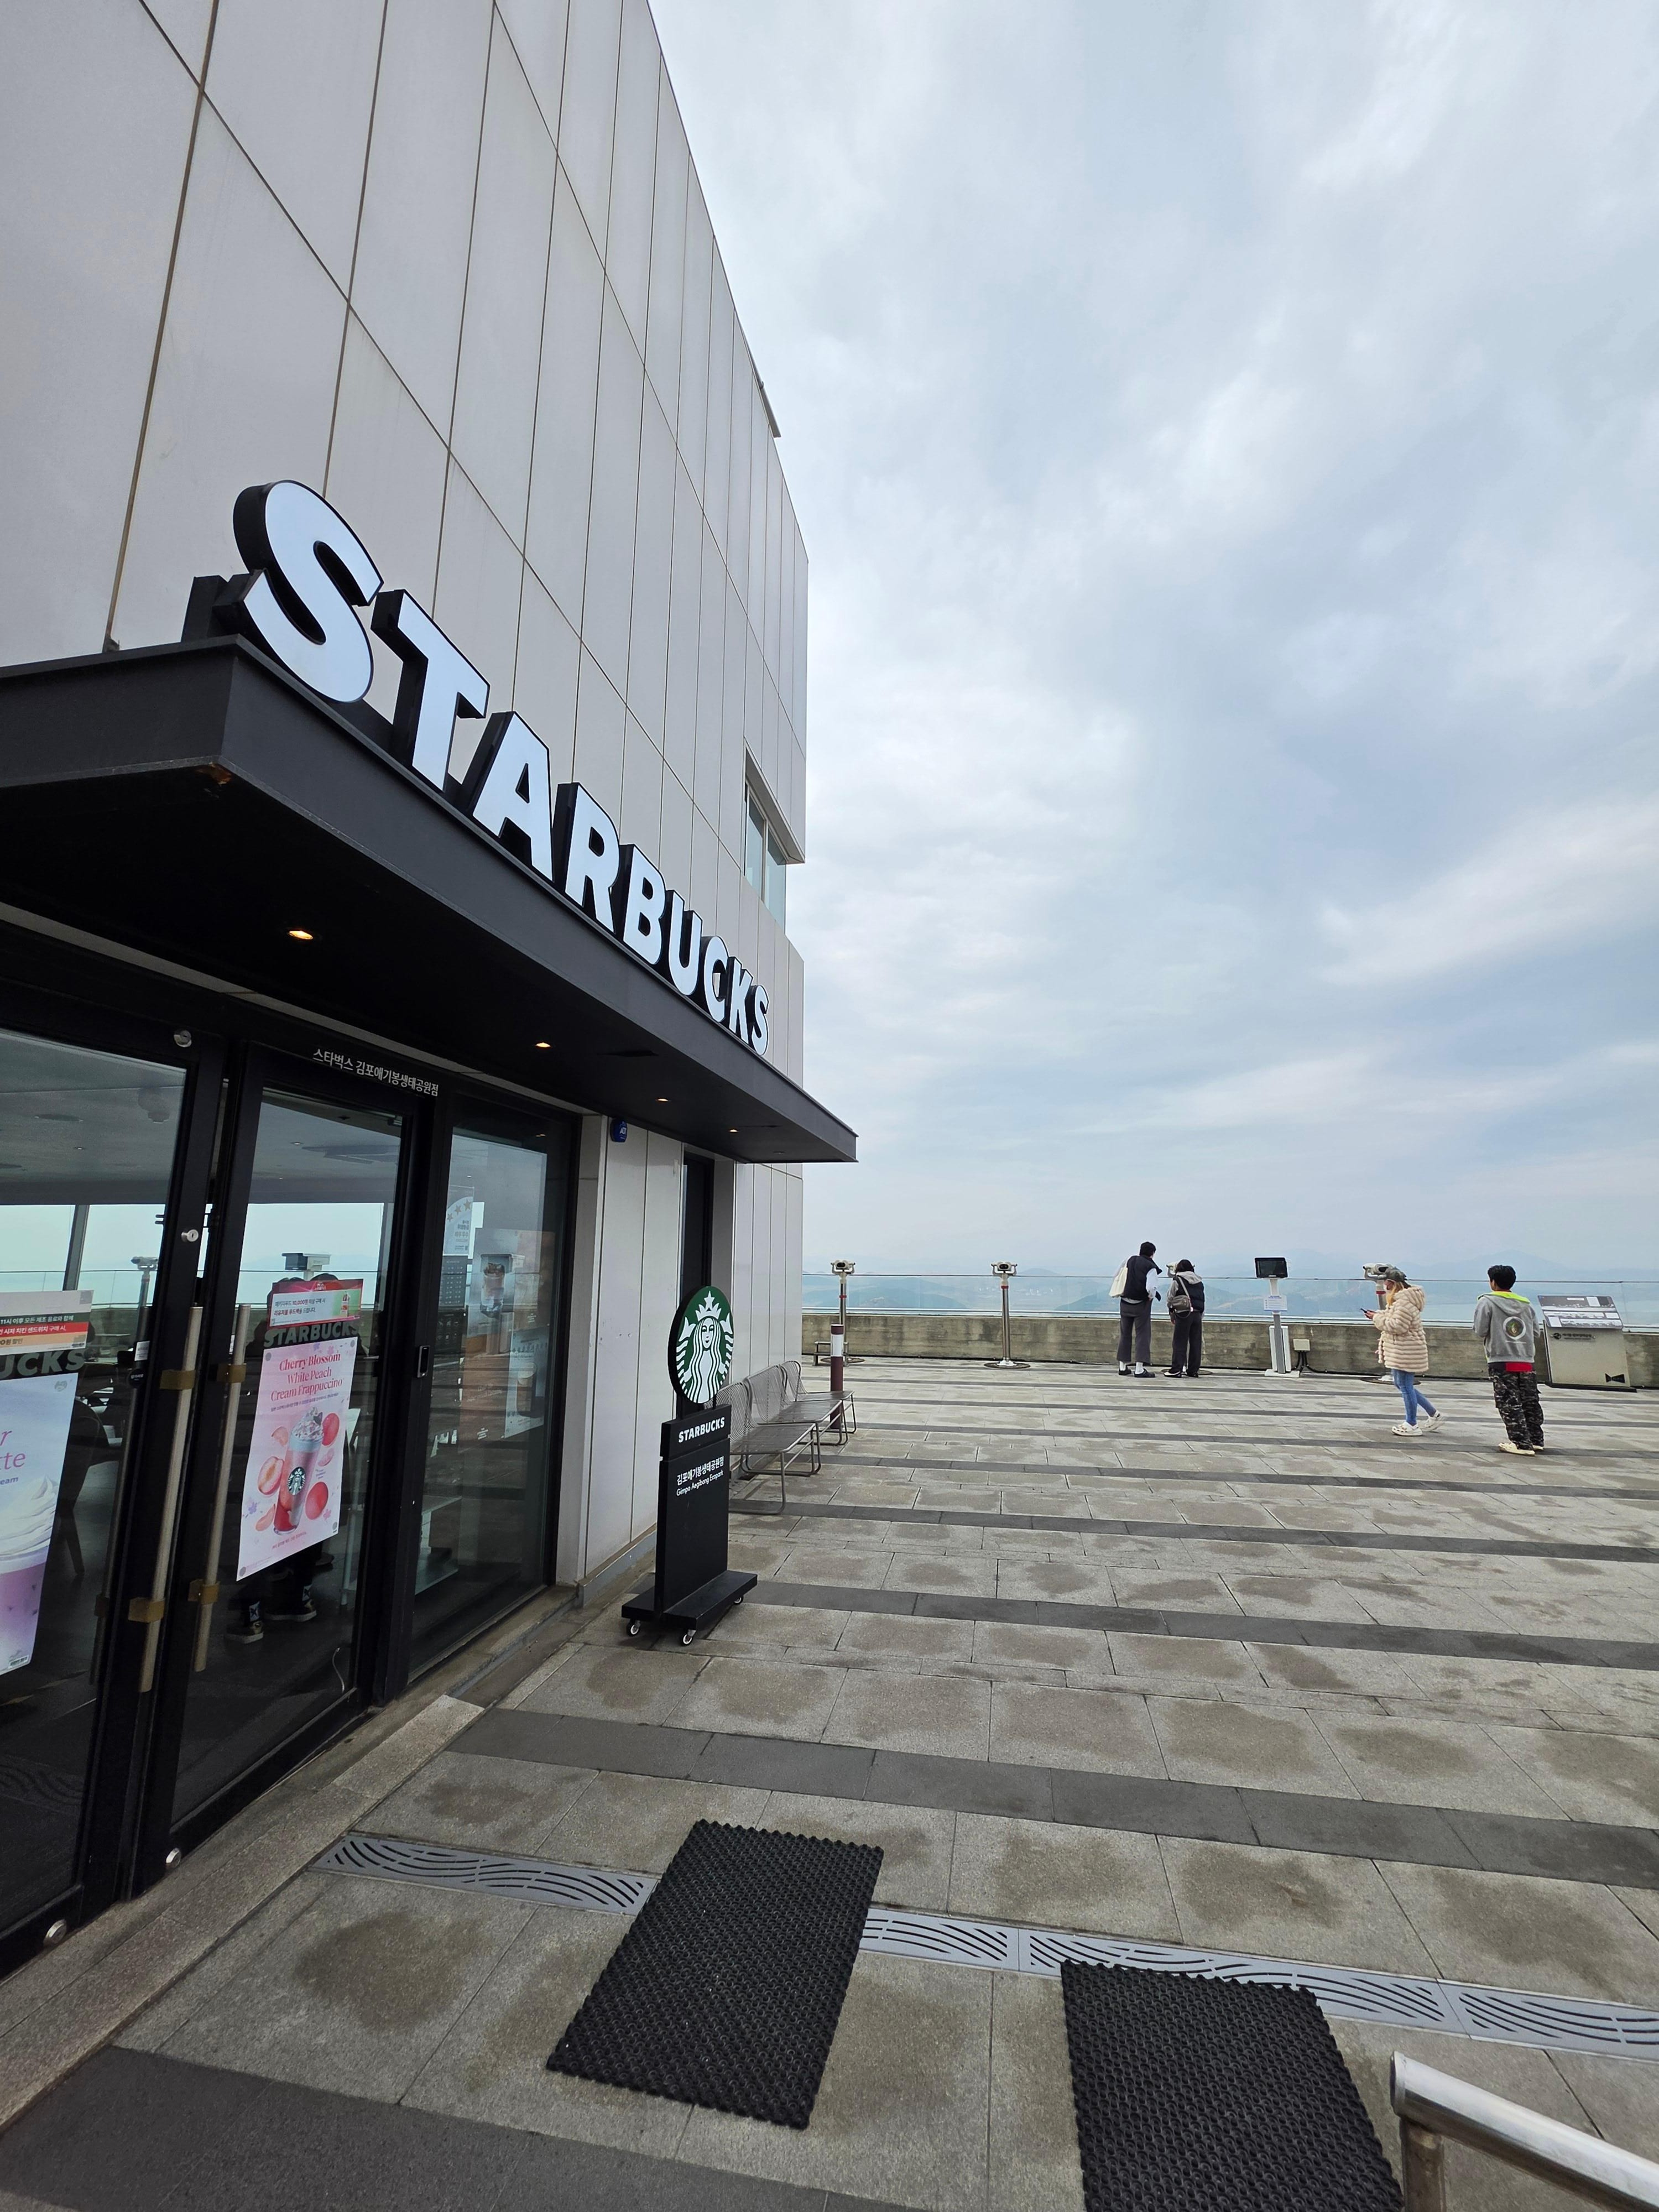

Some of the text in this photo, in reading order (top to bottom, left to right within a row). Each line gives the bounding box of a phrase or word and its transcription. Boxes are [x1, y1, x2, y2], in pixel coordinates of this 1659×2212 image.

[235, 479, 769, 1055] STARBUCKS
[313, 1048, 439, 1097] 스타벅스 김포애기봉생태공원점
[263, 1322, 358, 1348] STARBUCKS
[279, 1353, 341, 1371] Cherry Blossom
[288, 1367, 332, 1384] White Peach
[271, 1389, 297, 1401] Cream
[298, 1378, 343, 1395] Frappuccino
[679, 1417, 725, 1443] STARBUCKS
[0, 1452, 26, 1470] te
[676, 1455, 724, 1486] 김포애기봉생태공원점
[676, 1470, 723, 1496] Gimpo Aegibong Ecopark
